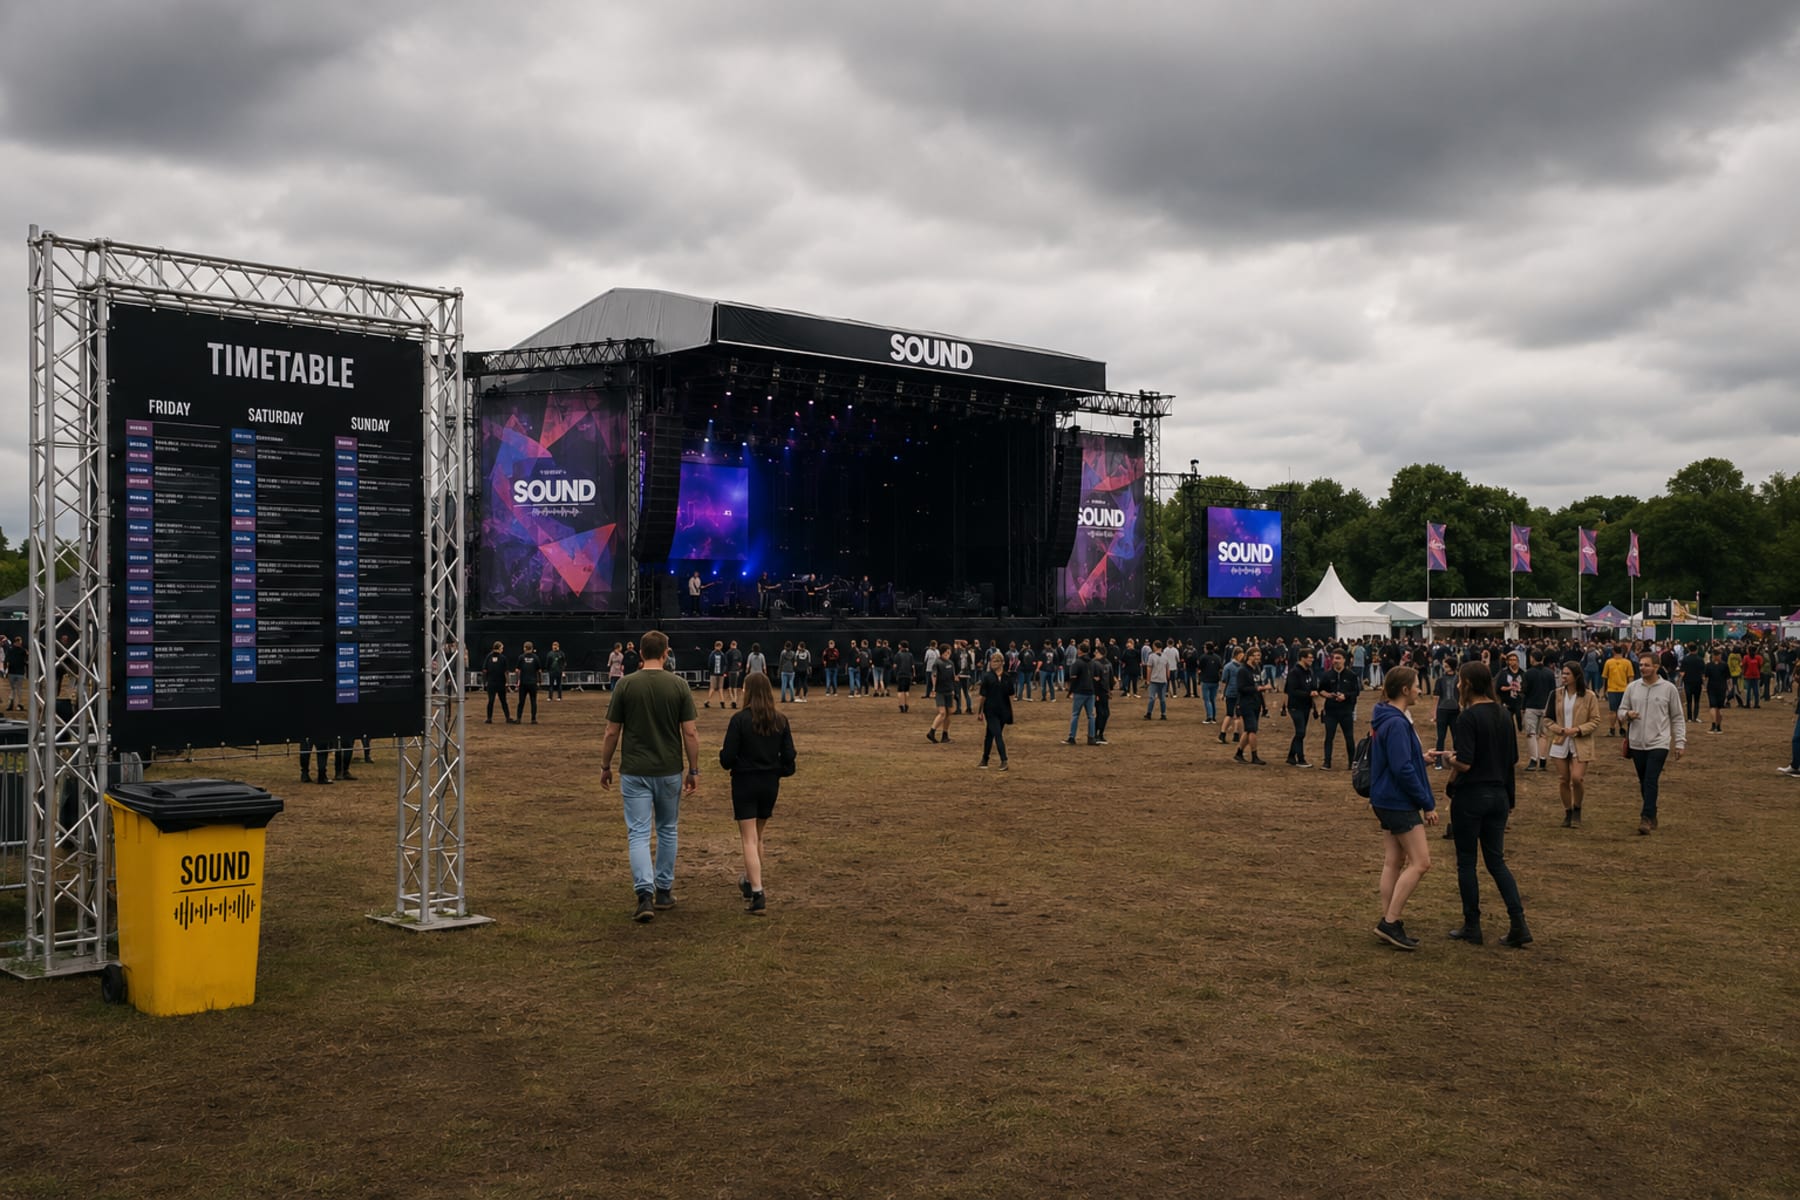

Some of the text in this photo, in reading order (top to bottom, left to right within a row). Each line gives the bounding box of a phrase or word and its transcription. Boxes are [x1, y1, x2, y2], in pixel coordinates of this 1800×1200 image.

[890, 333, 974, 371] SOUND
[207, 341, 355, 389] TIMETABLE
[149, 399, 191, 417] FRIDAY
[248, 408, 304, 425] SATURDAY
[351, 416, 390, 433] SUNDAY
[513, 479, 596, 503] SOUND
[1218, 541, 1274, 564] SOUND
[1450, 602, 1489, 617] DRINKS
[181, 851, 251, 885] SOUND
